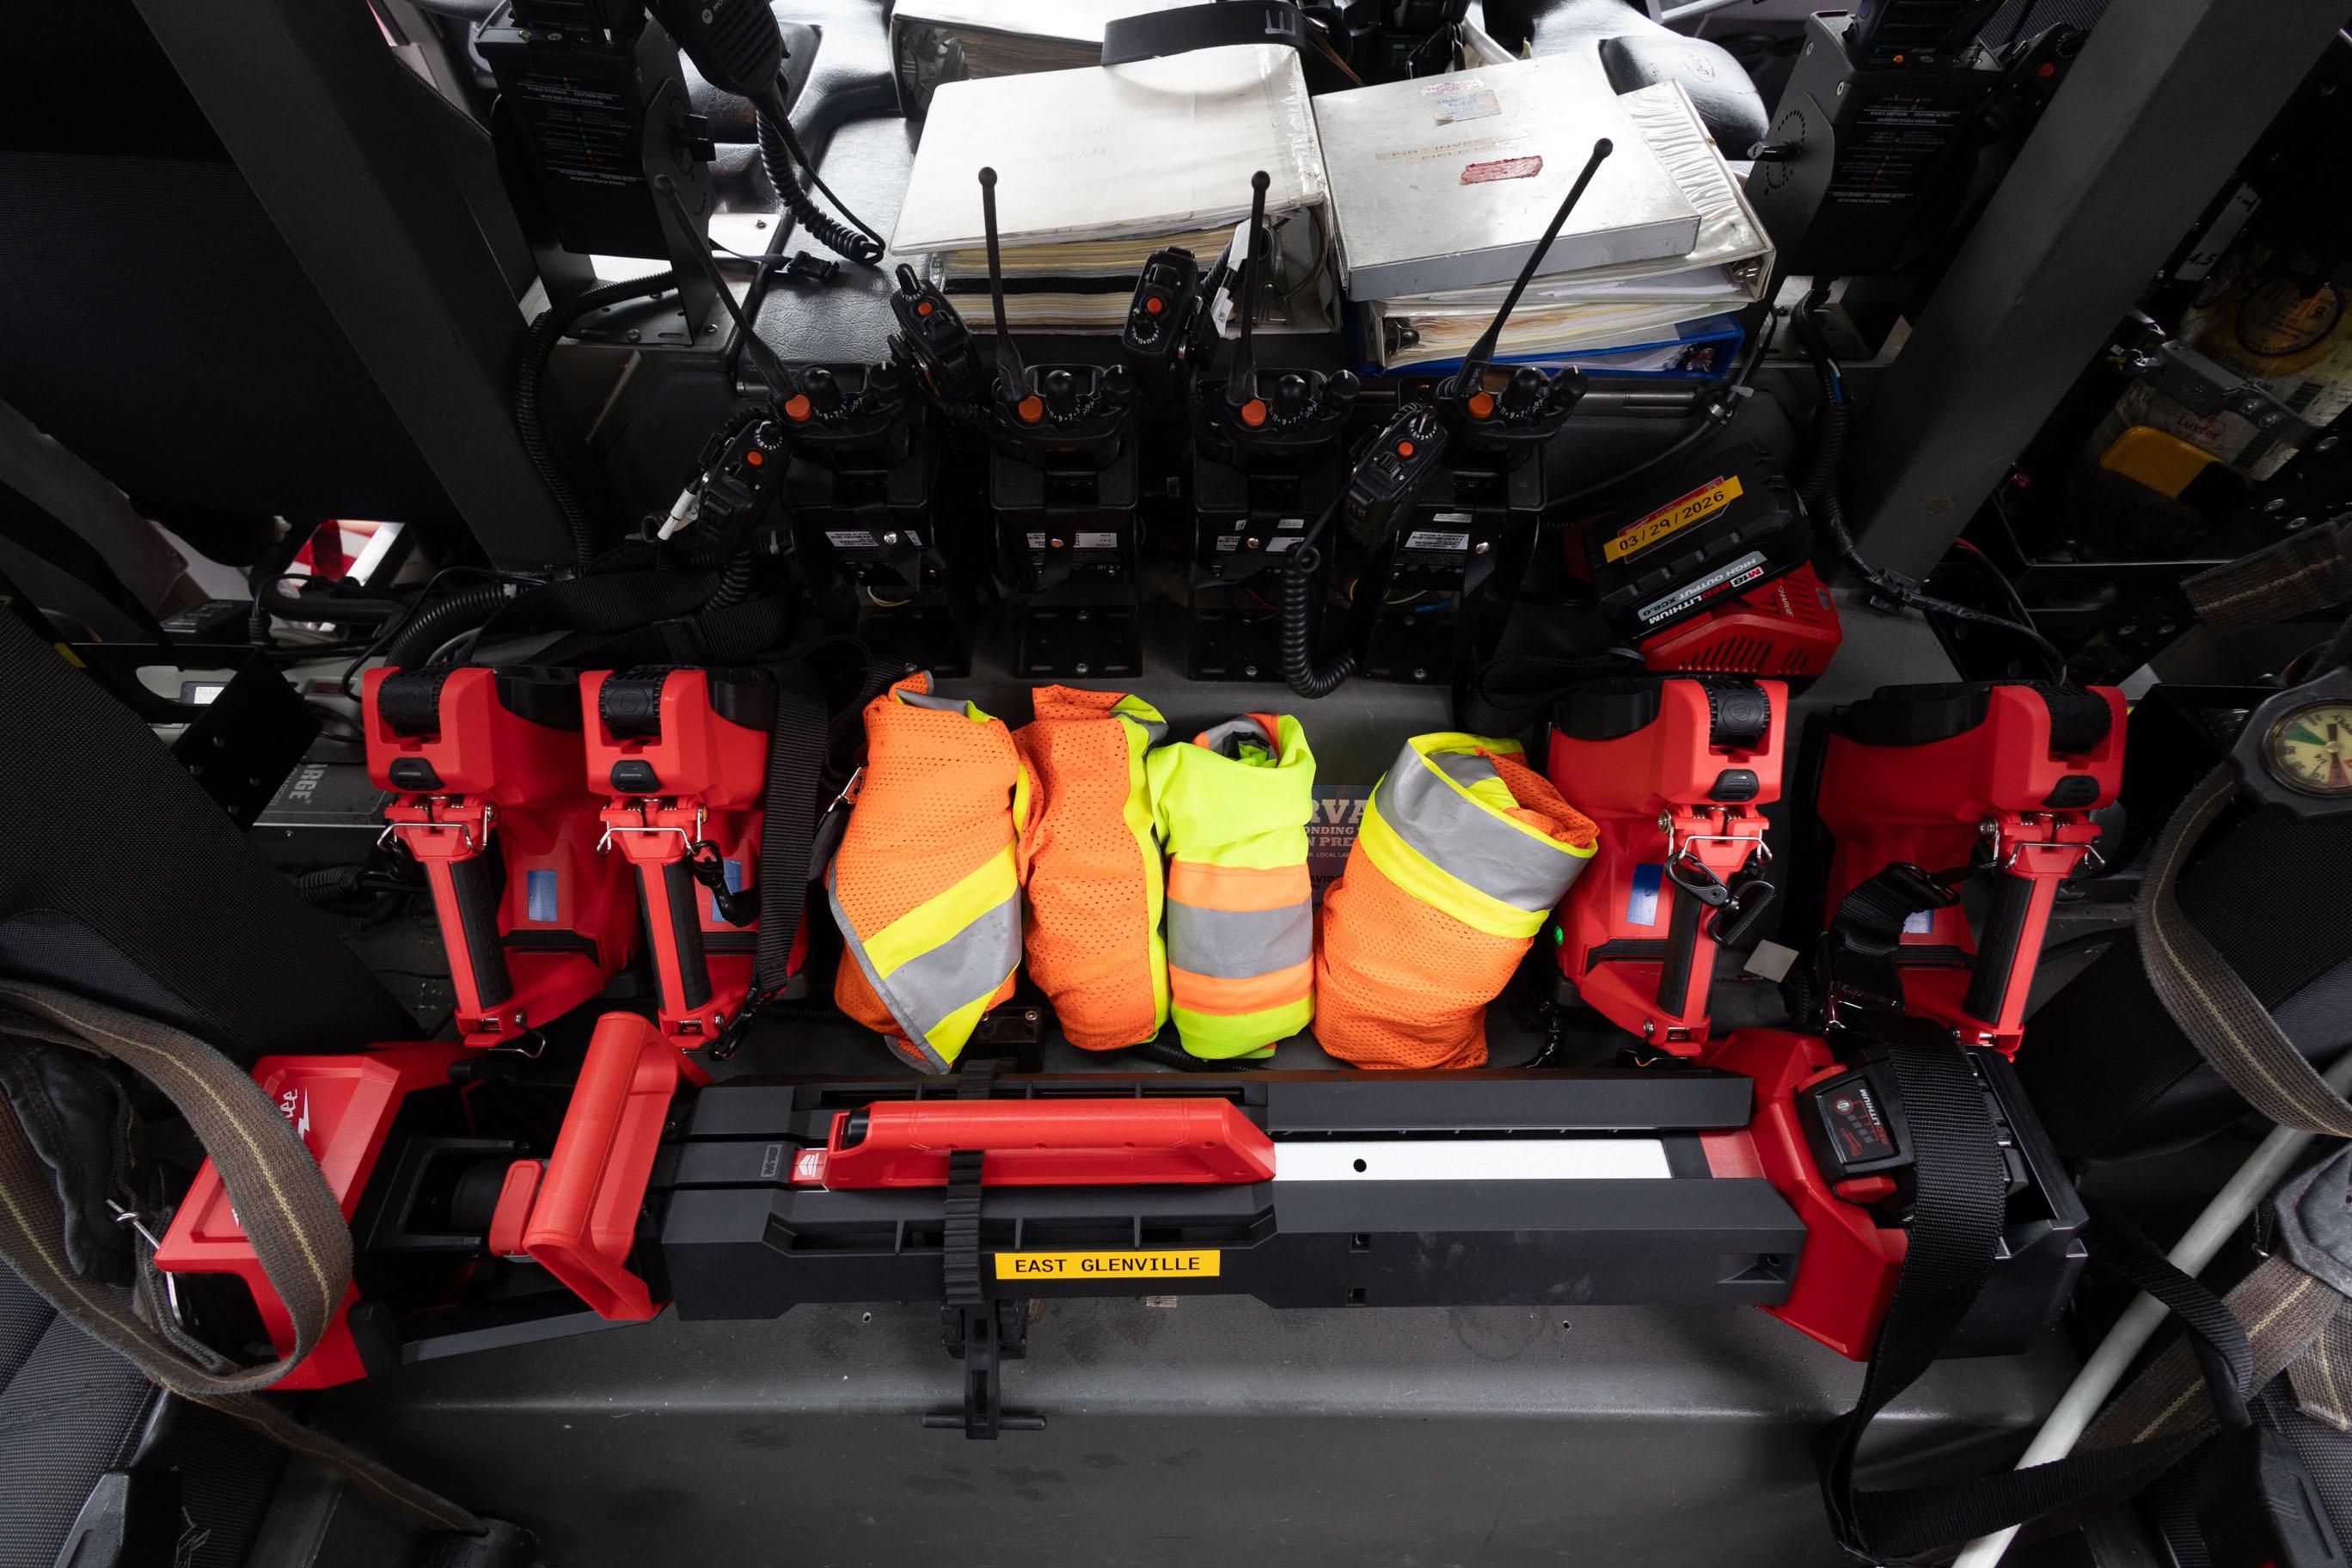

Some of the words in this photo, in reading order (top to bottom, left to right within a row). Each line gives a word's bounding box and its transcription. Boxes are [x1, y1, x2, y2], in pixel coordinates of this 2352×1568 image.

[1620, 536, 1638, 552] 03
[1651, 519, 1671, 535] 29
[1683, 491, 1724, 519] 2026
[1726, 557, 1756, 576] HIGH
[1733, 567, 1762, 585] M18
[1678, 574, 1724, 600] OUTPUT
[1649, 581, 1730, 624] REDLITHIUM
[1319, 837, 1357, 848] PRE
[1015, 1259, 1067, 1273] EAST
[1081, 1257, 1200, 1272] GLENVILLE
